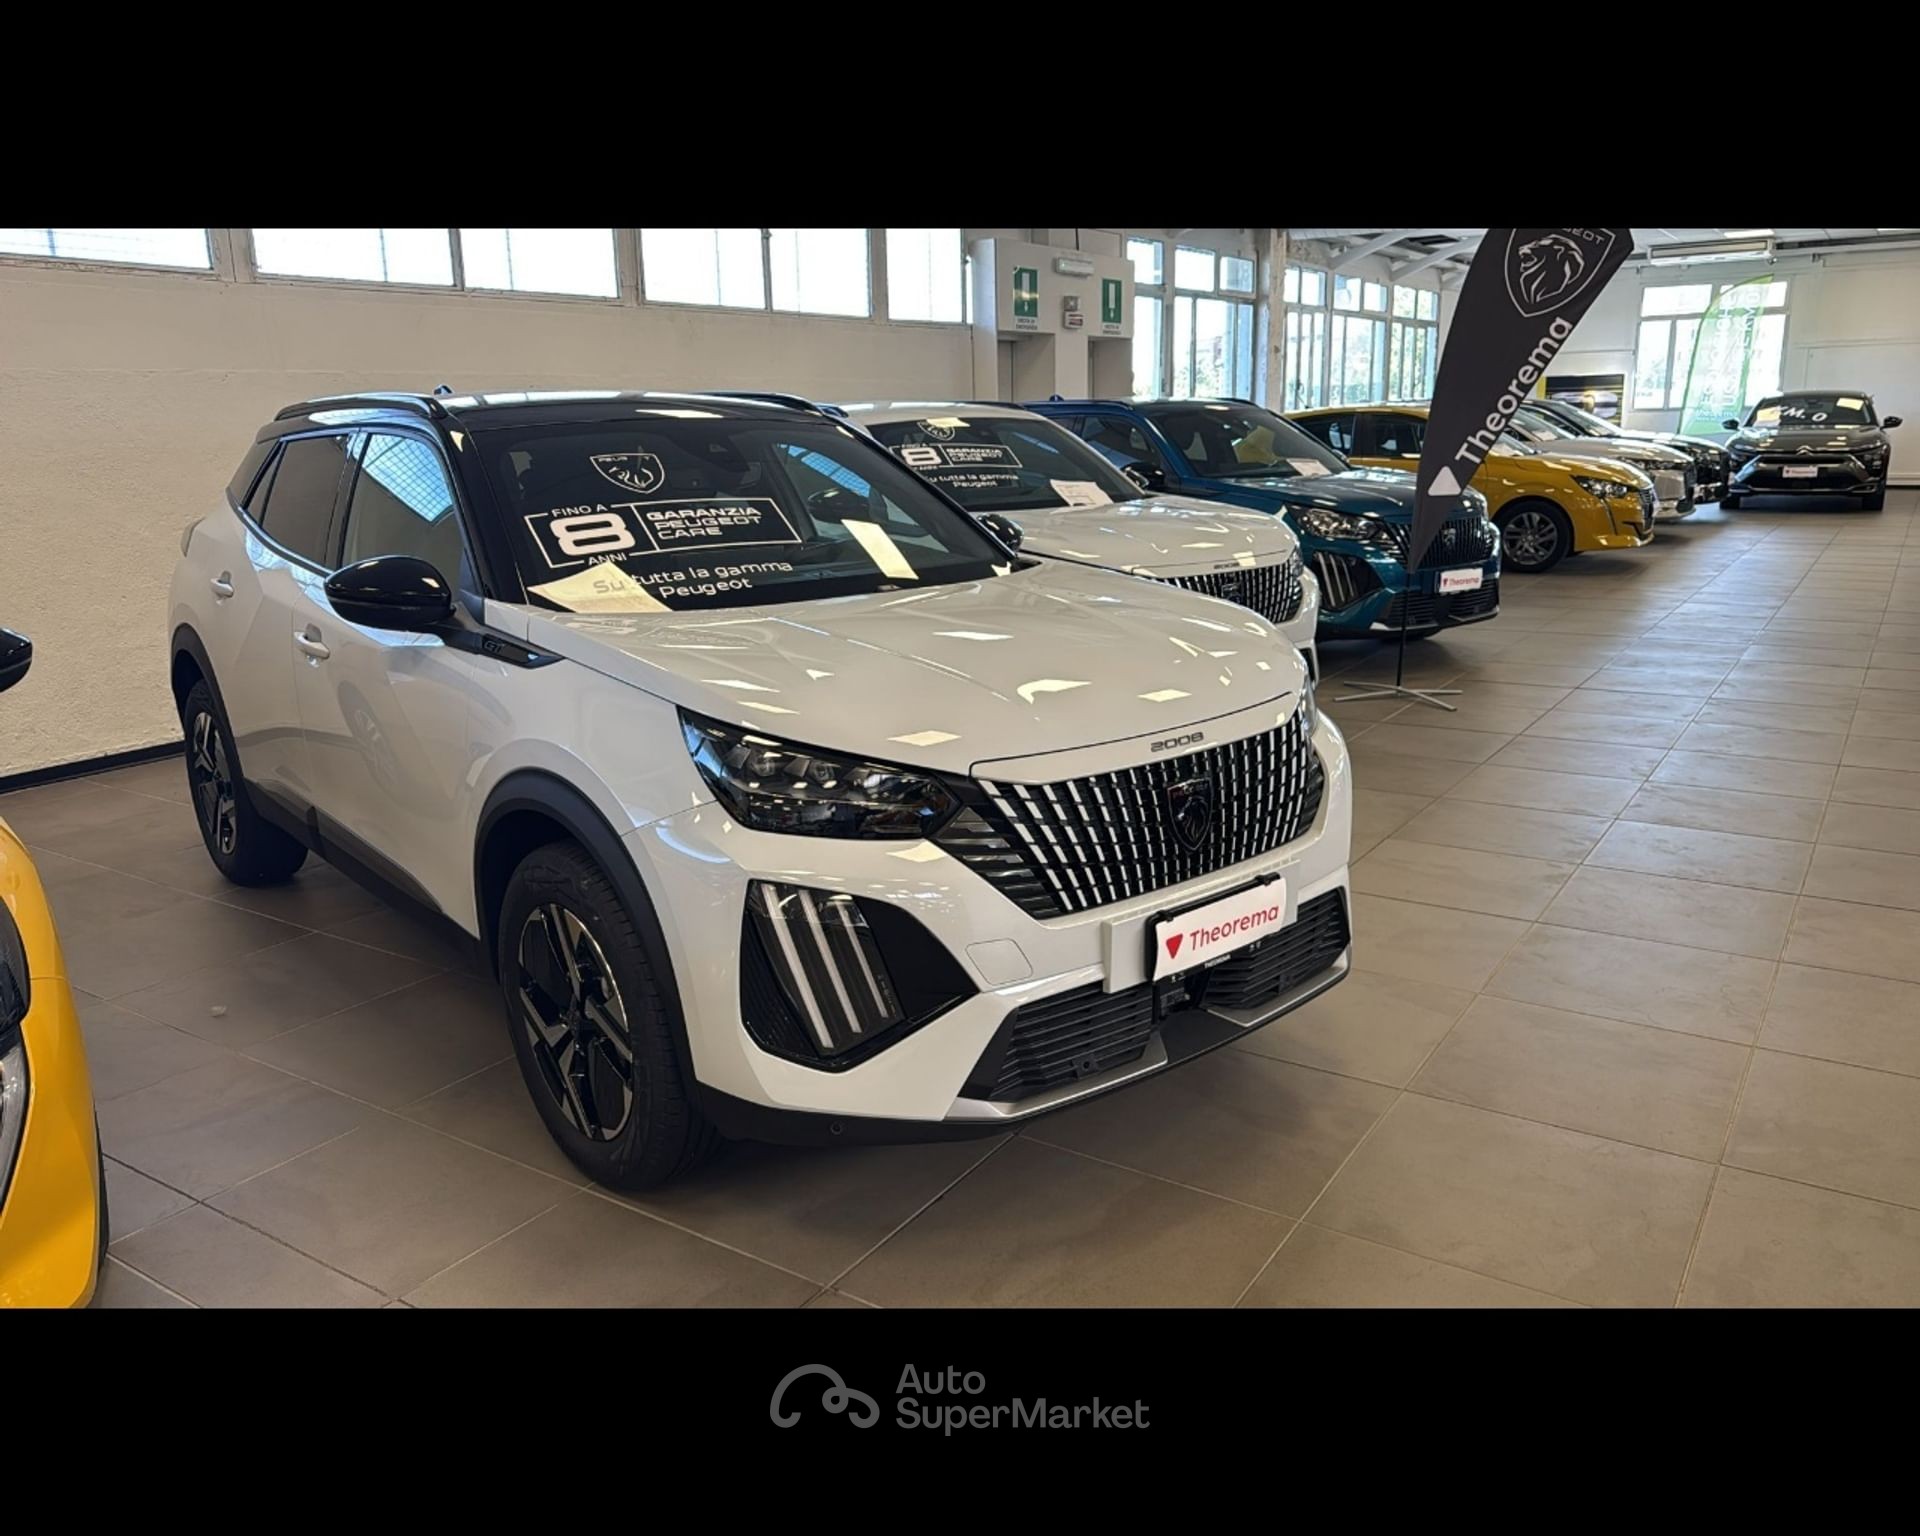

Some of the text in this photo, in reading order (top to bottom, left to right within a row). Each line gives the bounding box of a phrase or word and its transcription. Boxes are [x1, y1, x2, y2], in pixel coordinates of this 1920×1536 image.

[1455, 316, 1573, 464] Theorema
[901, 447, 942, 467] 8
[551, 503, 608, 518] FINO A
[646, 506, 762, 521] GARANZIA
[653, 515, 762, 531] PEUGEOT
[657, 526, 722, 540] CARE
[550, 513, 636, 556] 8
[588, 552, 627, 567] ANNI
[593, 561, 793, 594] Su tutta la gamma
[658, 577, 752, 600] Peugeot
[1150, 731, 1204, 753] 2008
[1190, 905, 1280, 951] Theorema
